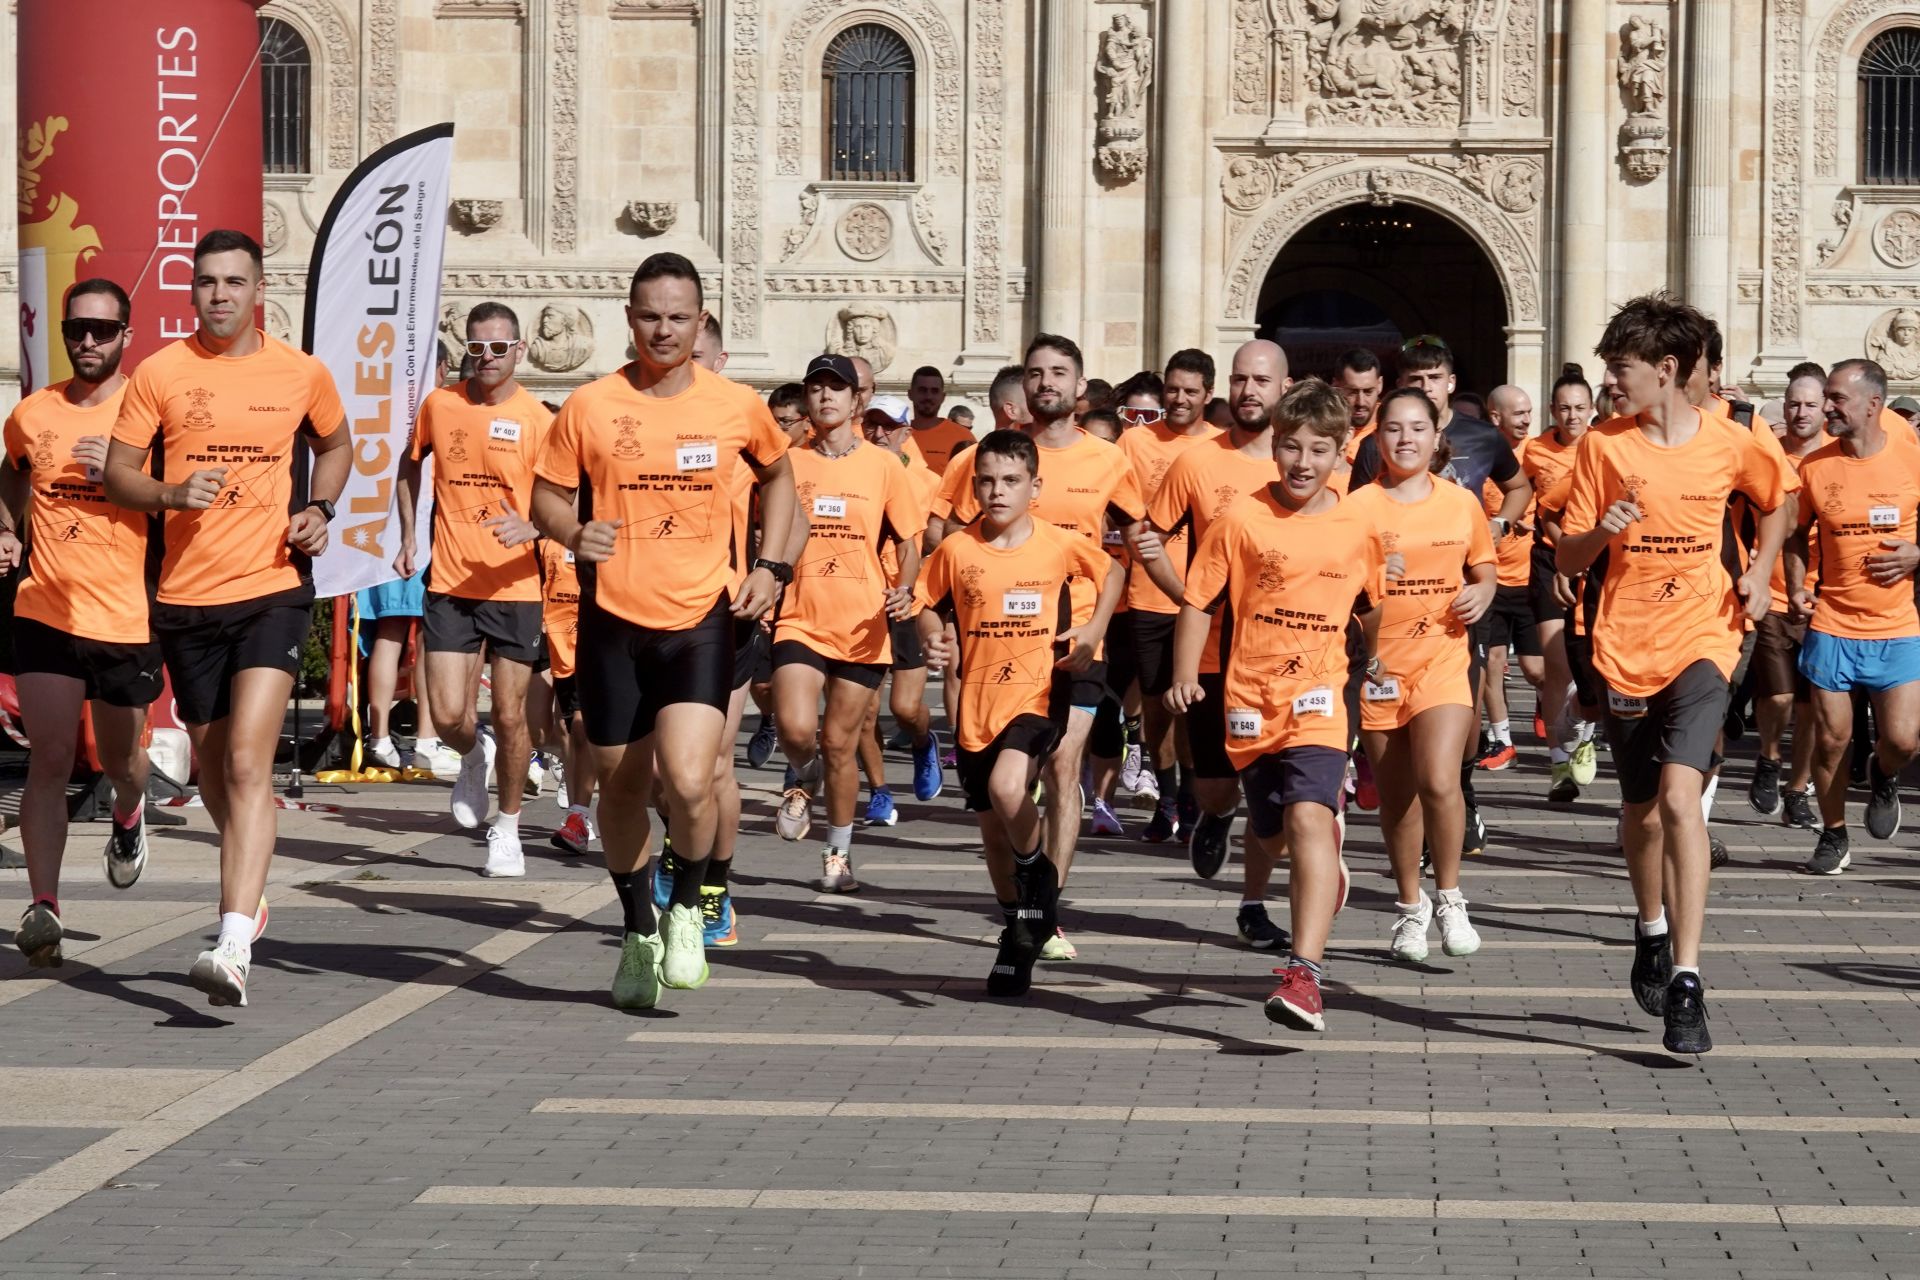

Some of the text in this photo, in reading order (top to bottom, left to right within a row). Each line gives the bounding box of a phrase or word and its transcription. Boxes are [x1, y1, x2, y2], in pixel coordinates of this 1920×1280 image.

[157, 26, 198, 291] DEPORTES
[413, 181, 426, 220] Sangre
[413, 223, 422, 233] la
[412, 234, 421, 249] de
[406, 252, 420, 331] Enfermedades
[406, 333, 415, 352] Las
[405, 355, 415, 377] Con
[207, 445, 264, 453] CORRE
[186, 454, 217, 462] POR
[696, 454, 712, 463] 223
[1641, 535, 1696, 543] CORRE
[1622, 544, 1652, 553] POR
[1682, 543, 1713, 554] VIDA
[1008, 601, 1036, 610] N° 539
[1274, 608, 1327, 622] CORRE
[1254, 613, 1283, 626] POR
[1286, 621, 1307, 630] LA
[1017, 628, 1049, 637] VIDA
[1310, 696, 1327, 705] 458
[1241, 721, 1255, 730] 649
[1017, 908, 1043, 919] PUMA
[992, 964, 1016, 975] PUMA
